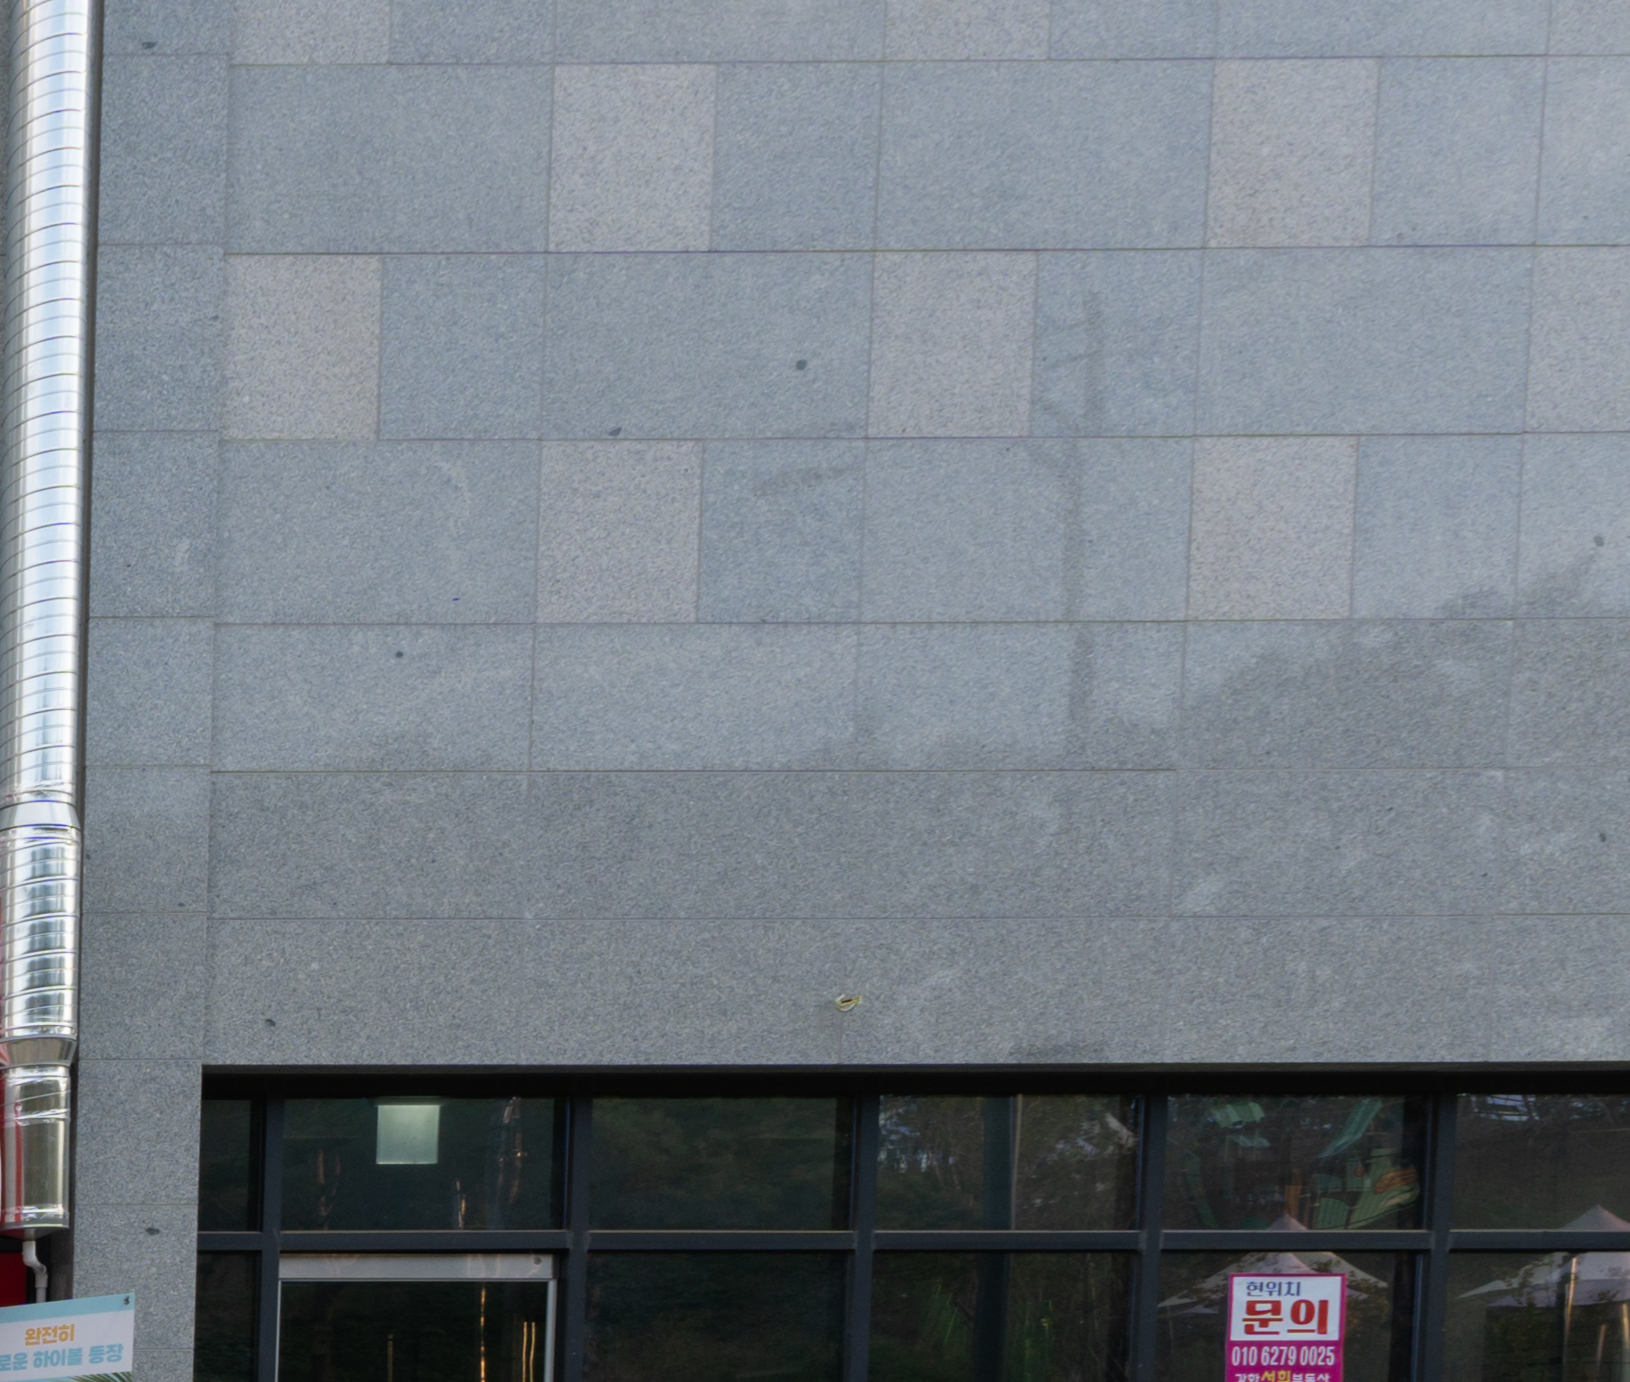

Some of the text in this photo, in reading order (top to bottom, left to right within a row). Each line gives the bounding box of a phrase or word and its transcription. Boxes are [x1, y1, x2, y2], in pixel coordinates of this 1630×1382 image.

[1246, 1281, 1301, 1297] 현위치
[1242, 1299, 1329, 1335] 문의
[25, 1324, 75, 1346] 완전히
[33, 1347, 83, 1369] 하이볼
[88, 1343, 124, 1365] 등장
[1232, 1346, 1336, 1366] 010 6279 0025
